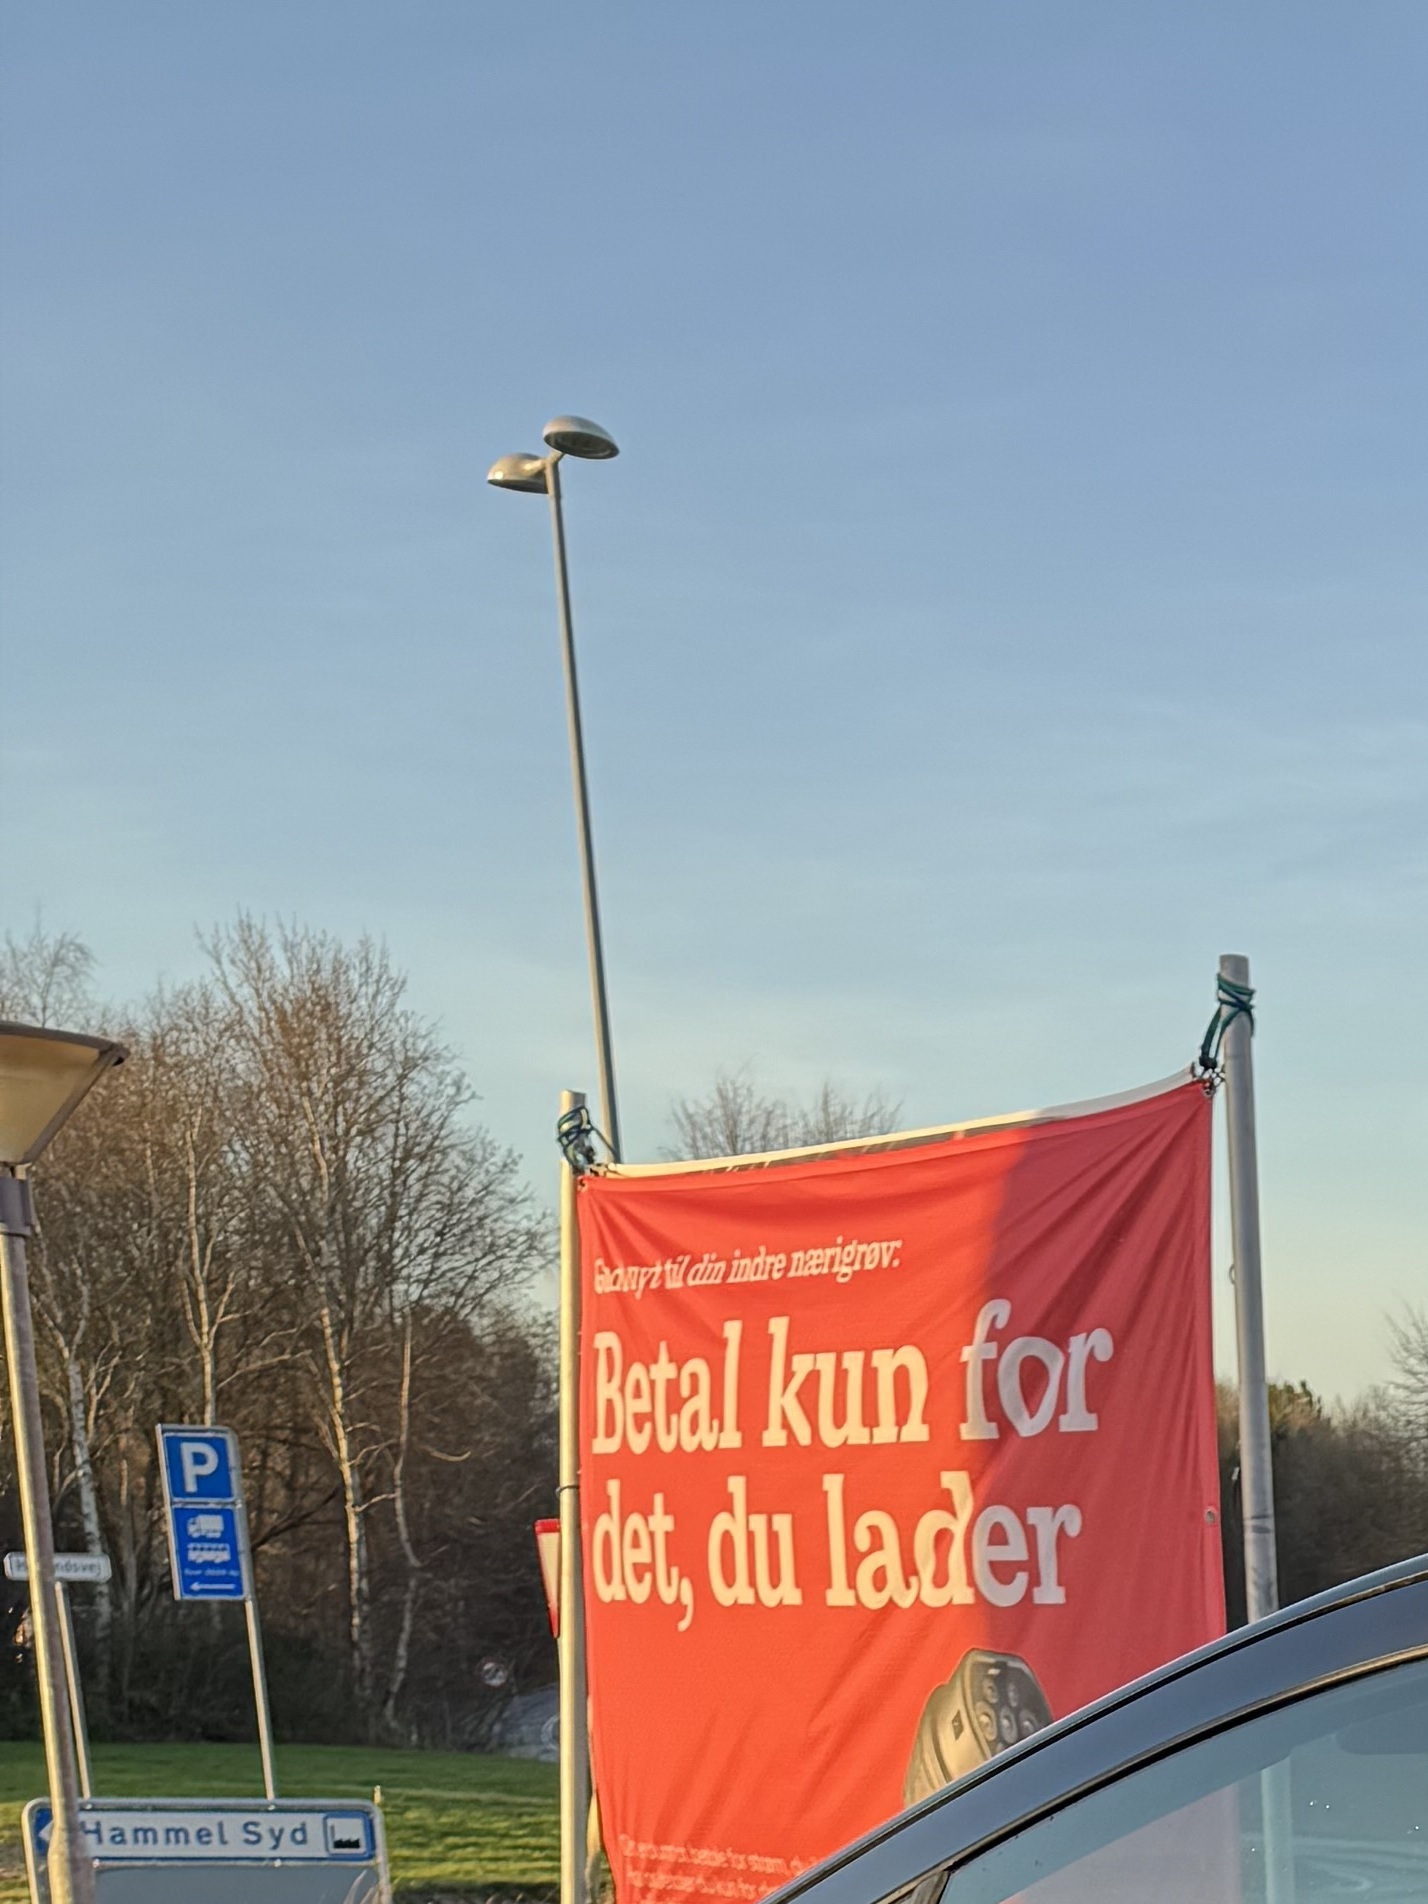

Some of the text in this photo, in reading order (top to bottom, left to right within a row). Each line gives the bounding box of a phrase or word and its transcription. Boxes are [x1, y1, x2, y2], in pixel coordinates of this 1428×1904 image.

[664, 1254, 691, 1289] til
[687, 1252, 727, 1287] din
[725, 1245, 787, 1284] indre
[592, 1299, 1113, 1455] Betal kun for
[180, 1441, 219, 1493] P
[593, 1470, 1082, 1631] det, du lader
[80, 1820, 308, 1850] Hammel Syd
